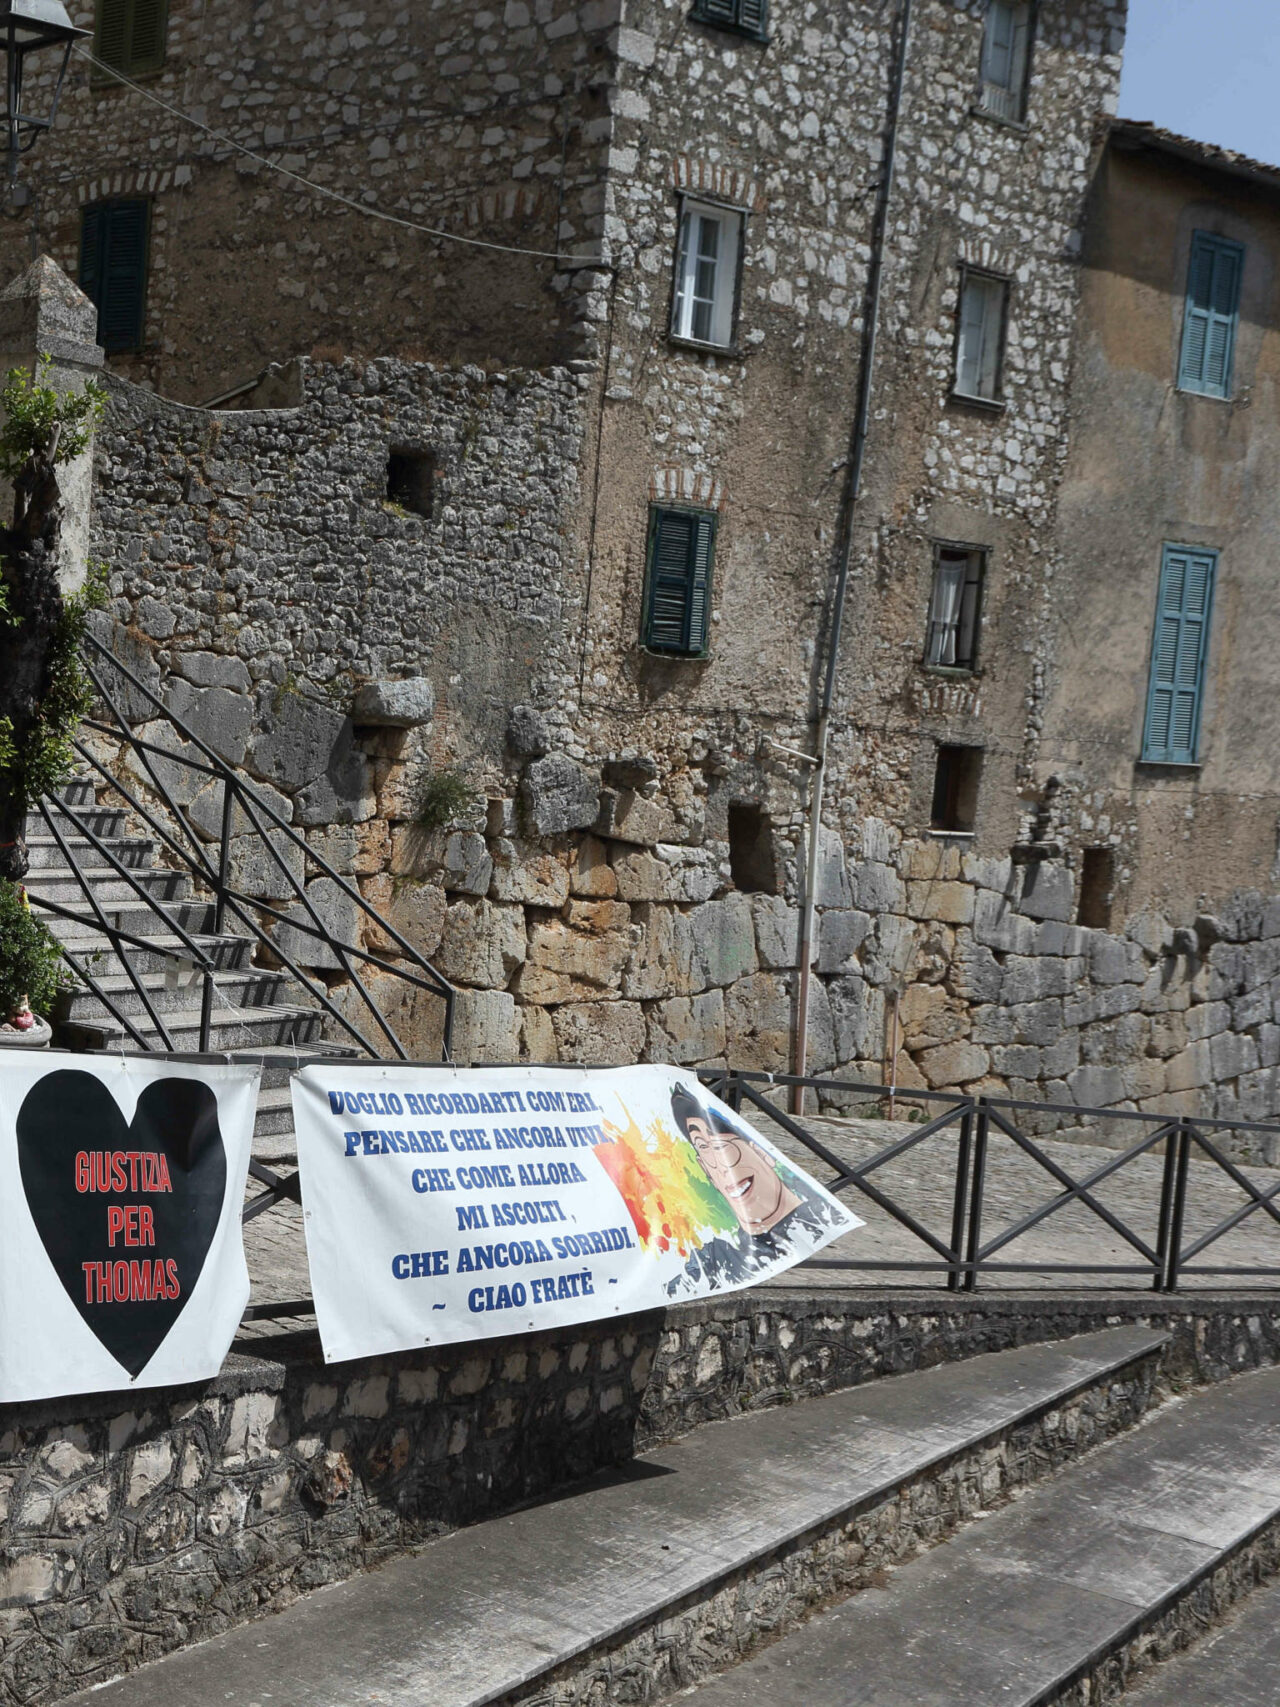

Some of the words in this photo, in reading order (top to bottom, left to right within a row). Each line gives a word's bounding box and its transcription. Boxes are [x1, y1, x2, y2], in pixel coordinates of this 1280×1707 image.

[328, 1091, 404, 1115] VOGLIO
[404, 1091, 526, 1115] RICORDARTI
[344, 1129, 447, 1157] PENSARE
[448, 1128, 491, 1151] CHE
[495, 1126, 568, 1149] ANCORA
[75, 1151, 172, 1192] GIUSTIZIA
[411, 1168, 456, 1194] CHE
[460, 1164, 516, 1190] COME
[519, 1162, 587, 1186] ALLORA
[107, 1205, 155, 1247] PER
[456, 1205, 489, 1231] MI
[492, 1200, 567, 1226] ASCOLTI
[391, 1250, 450, 1280] CHE
[456, 1242, 554, 1273] ANCORA
[556, 1226, 636, 1260] SORRIDI.
[82, 1258, 181, 1304] THOMAS
[468, 1285, 528, 1312] CIAO
[531, 1267, 595, 1305] FRATÈ
